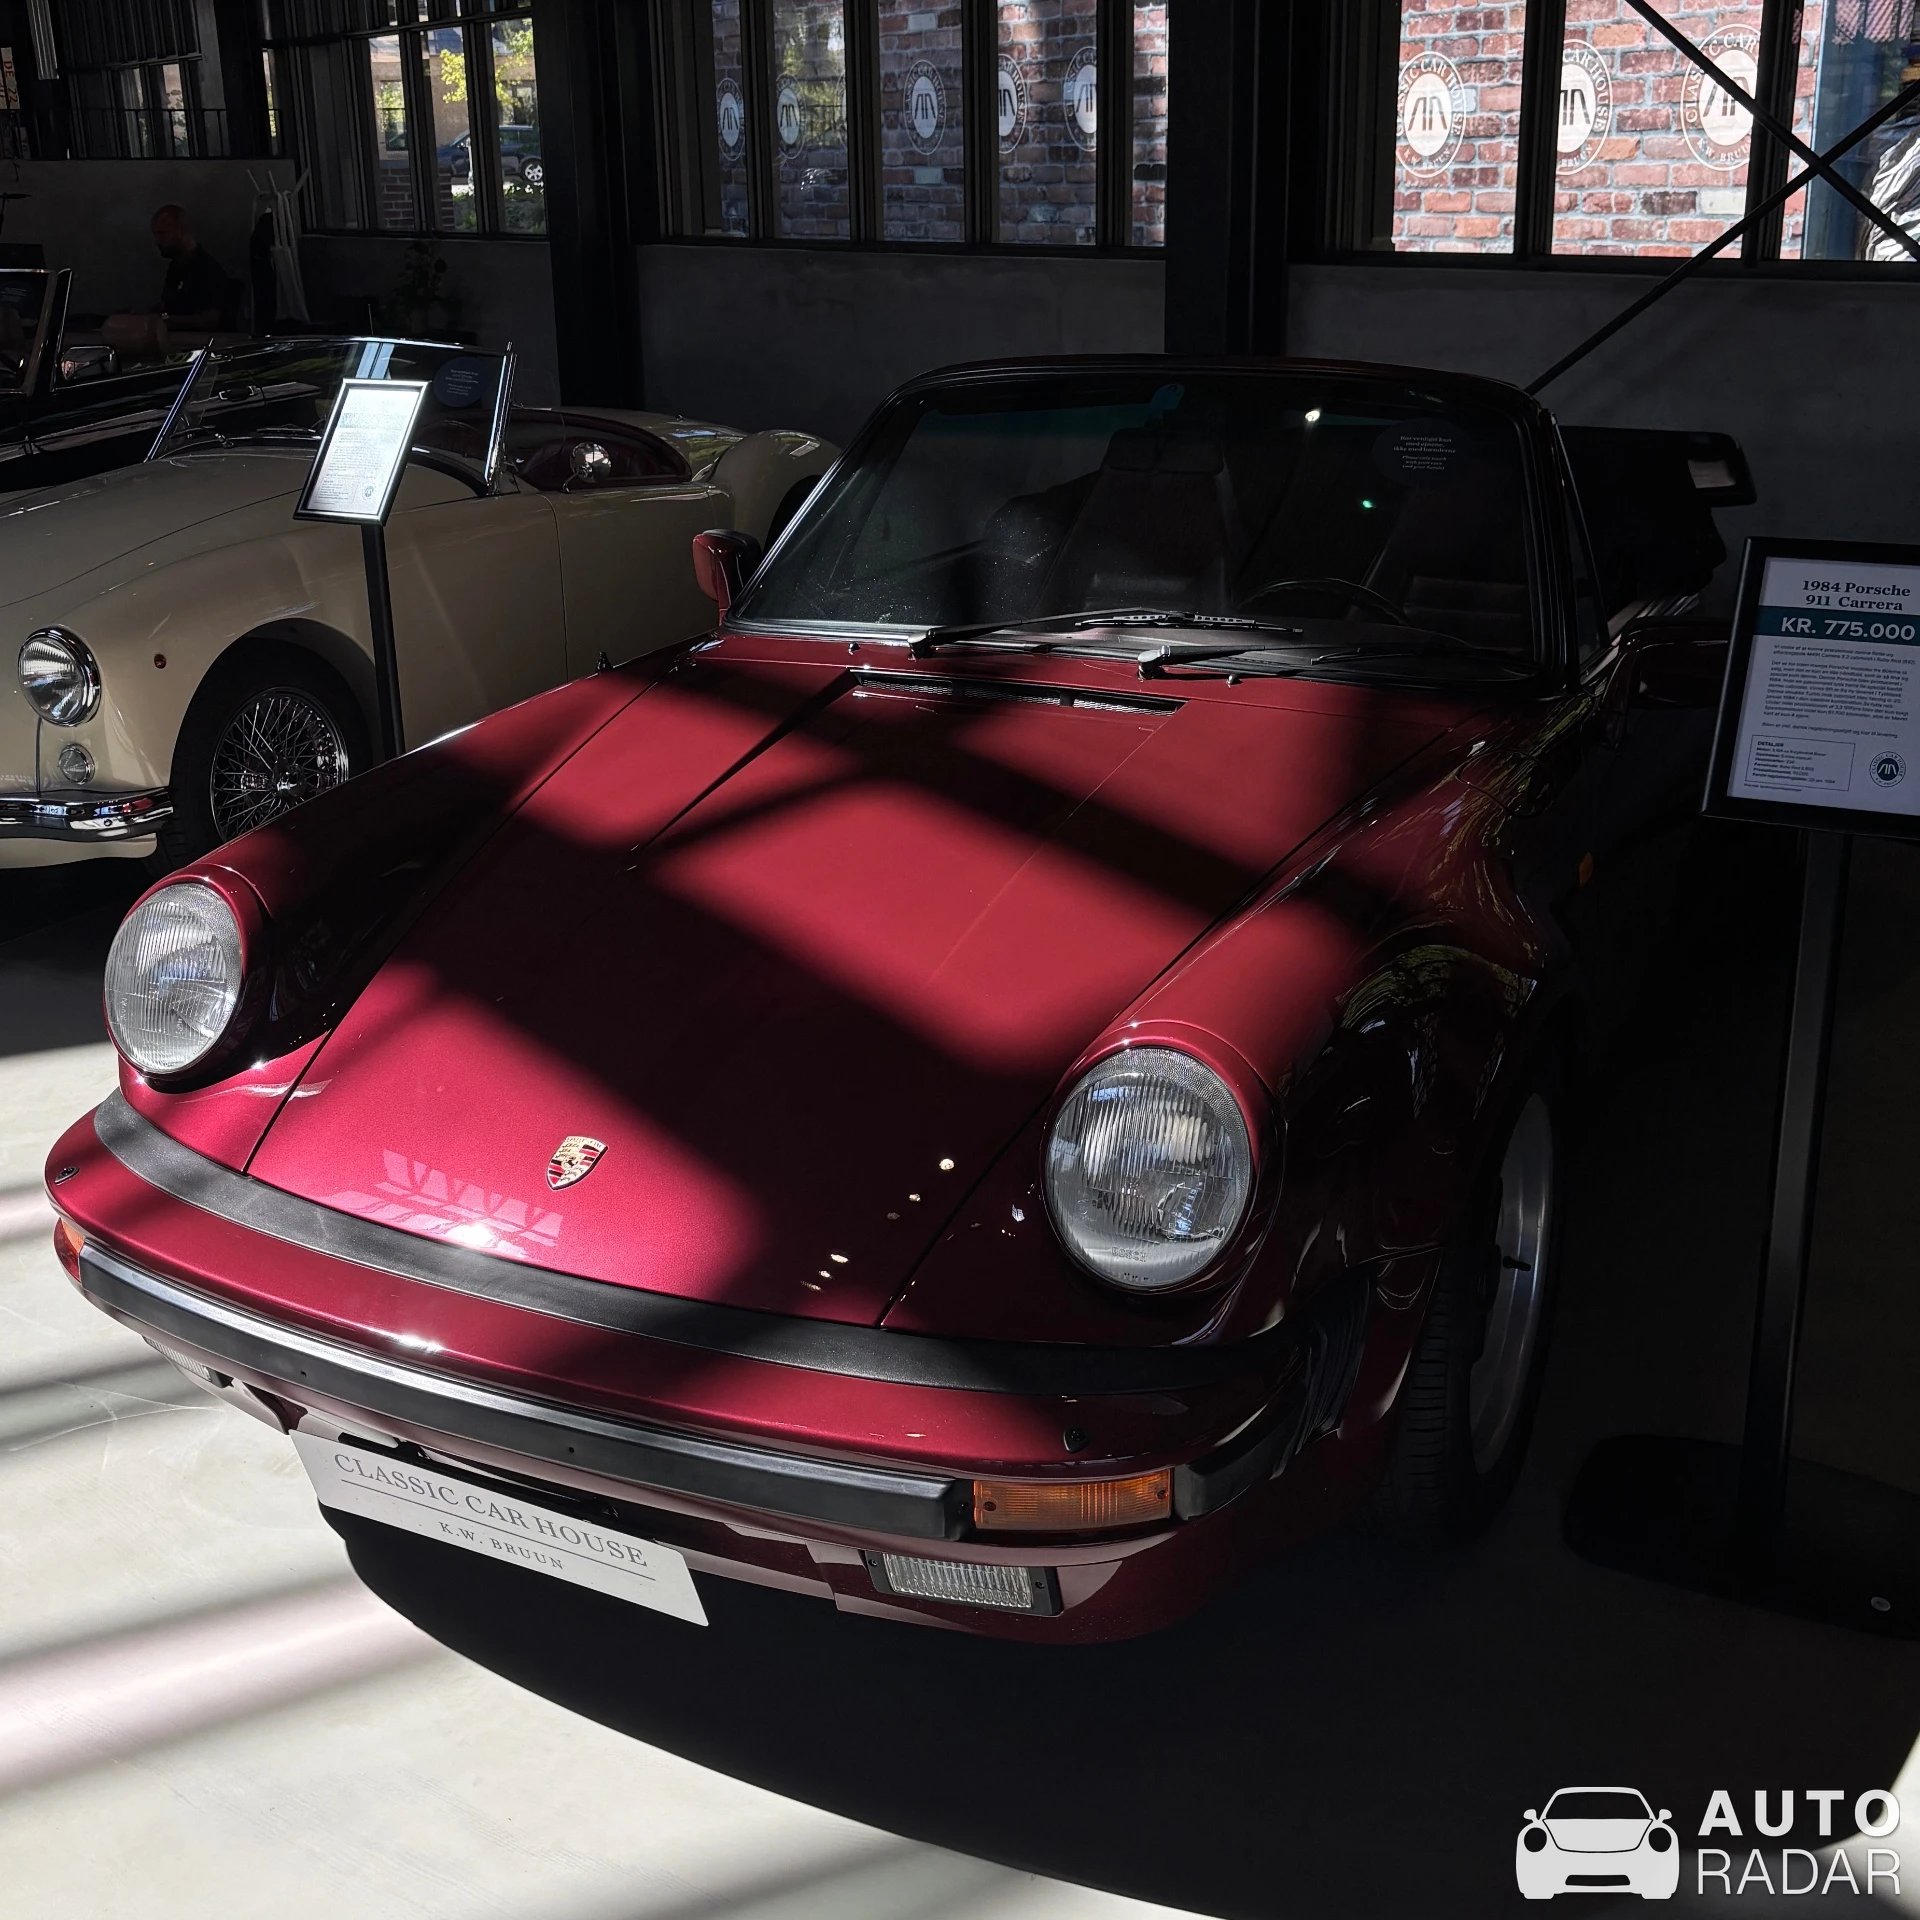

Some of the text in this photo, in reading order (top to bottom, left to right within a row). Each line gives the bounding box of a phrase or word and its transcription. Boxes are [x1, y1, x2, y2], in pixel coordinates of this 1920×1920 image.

[1421, 58, 1446, 77] CAR
[1446, 72, 1463, 136] HOUSE
[1589, 64, 1608, 132] HOUSE
[1686, 32, 1756, 123] CLASC CAR
[1802, 580, 1911, 597] 1984 Porsche
[1805, 594, 1903, 611] 911 Carrera
[1781, 616, 1916, 641] KR. 775.000
[334, 1454, 648, 1568] CLASSIC CAR HOUSE
[439, 1521, 563, 1570] K.W. BRUUN
